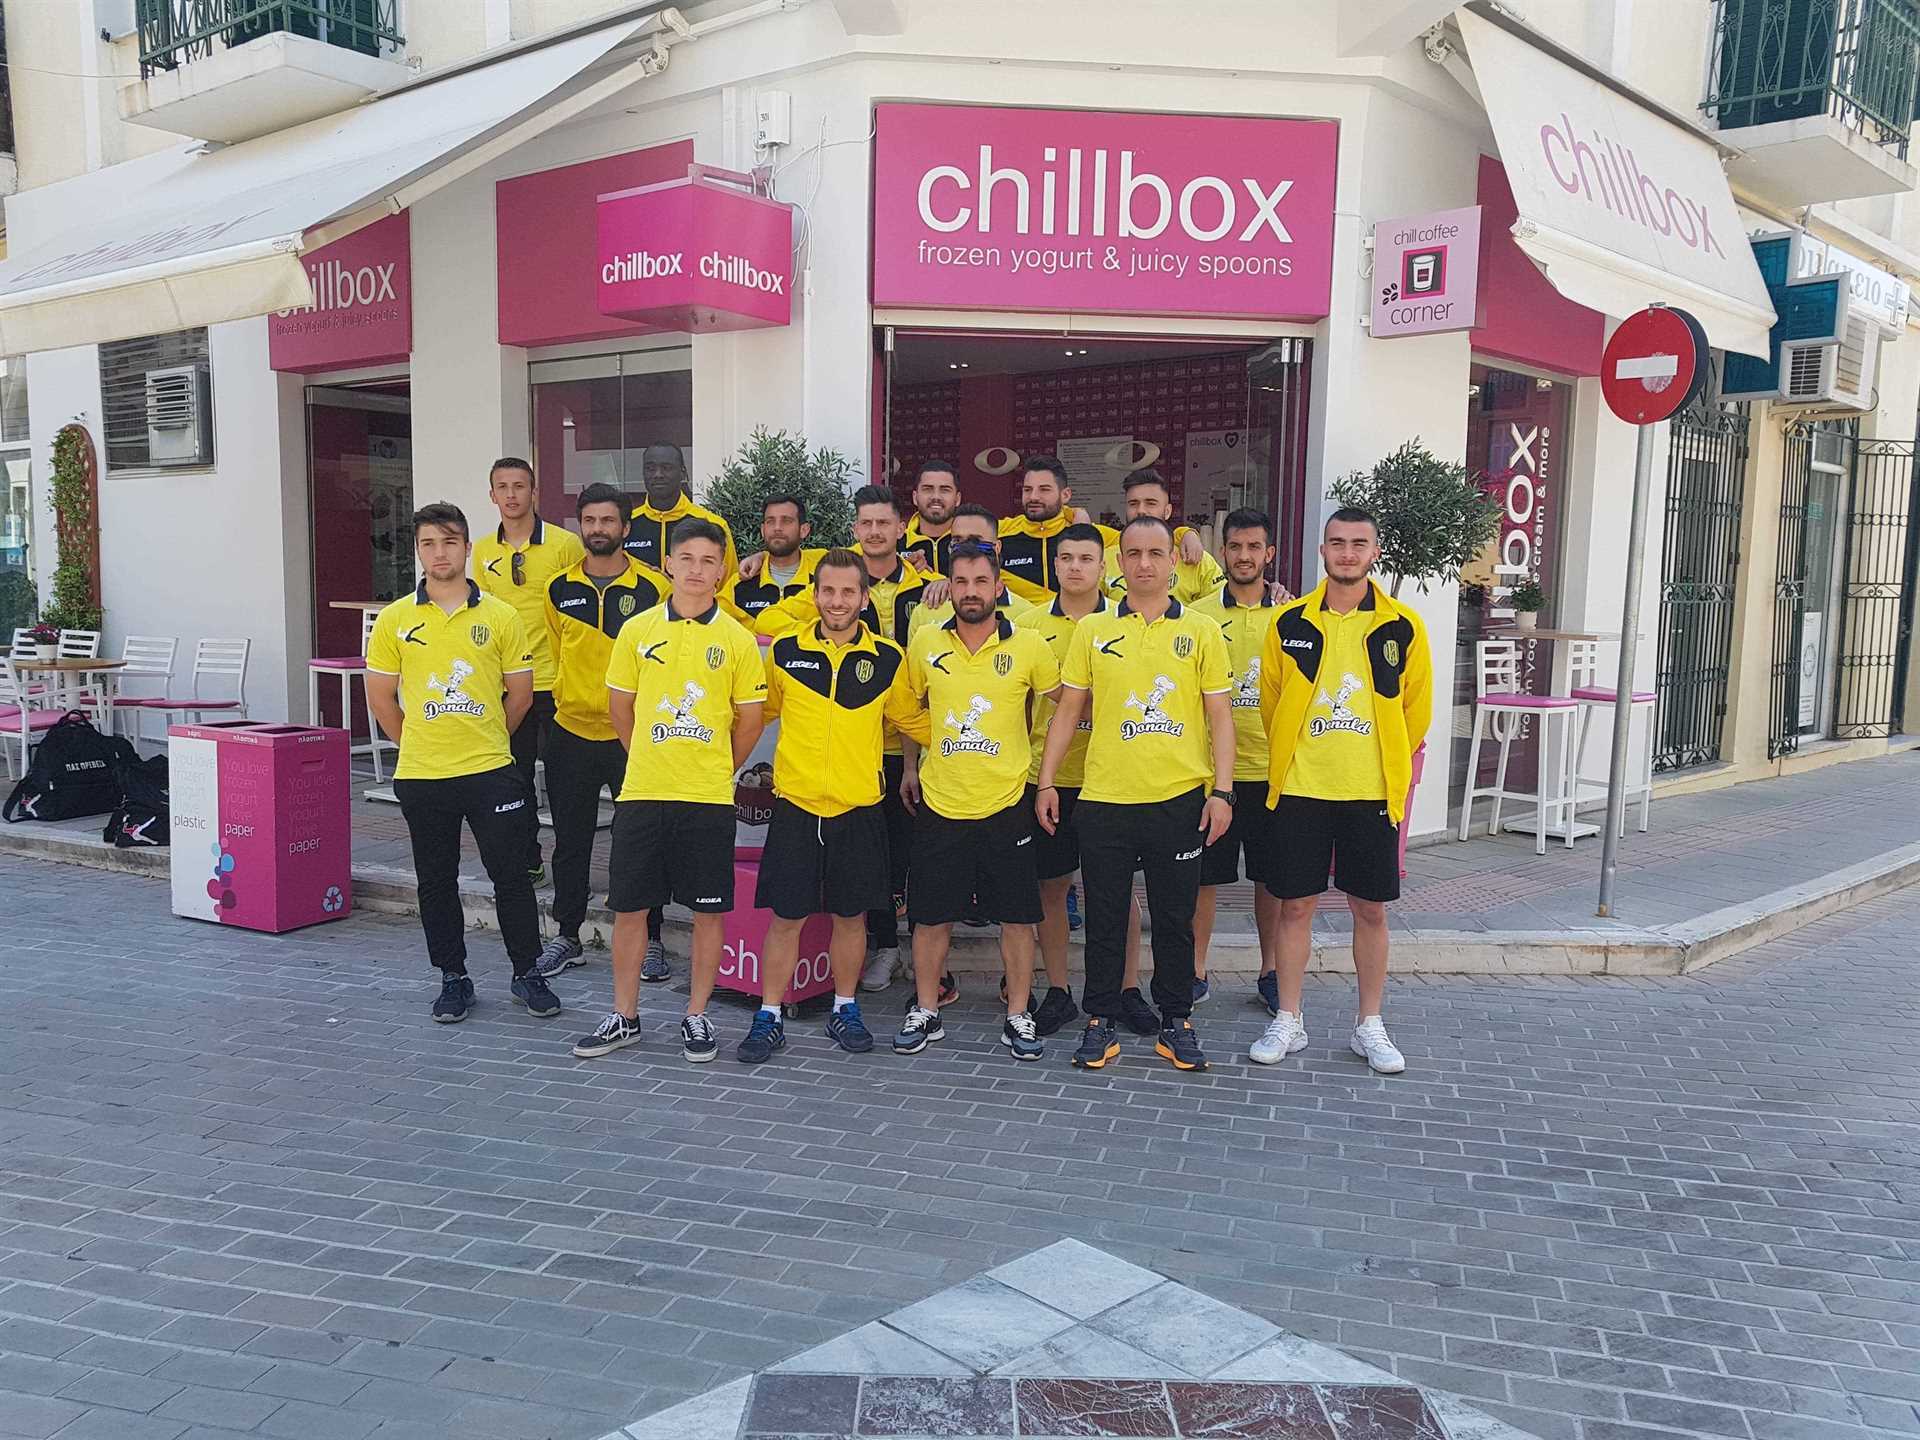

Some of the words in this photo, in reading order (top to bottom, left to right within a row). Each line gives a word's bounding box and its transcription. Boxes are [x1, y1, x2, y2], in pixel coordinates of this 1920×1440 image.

[917, 145, 1294, 244] chillbox
[1540, 112, 1727, 260] chillbox
[1393, 228, 1417, 246] chill
[1418, 223, 1459, 242] coffee
[602, 251, 683, 285] chillbox
[917, 241, 1000, 266] frozen
[1010, 247, 1094, 275] yogurt
[1102, 246, 1121, 271] &
[1128, 248, 1189, 279] juicy
[1198, 255, 1293, 279] spoons
[699, 251, 784, 295] chillbox
[276, 260, 397, 318] illbox
[1390, 302, 1455, 325] corner
[1539, 427, 1550, 478] more
[1537, 485, 1546, 498] &
[624, 540, 652, 548] LEGEA
[1533, 506, 1544, 566] cream
[1004, 557, 1033, 566] LEGEA
[560, 598, 587, 608] LEGEA
[745, 601, 770, 609] LEGEA
[785, 661, 820, 670] LEGEA
[424, 700, 485, 720] Donald
[651, 723, 714, 743] Donald
[1120, 720, 1184, 740] Donald
[941, 737, 1000, 757] Donald
[174, 815, 207, 830] plastic
[754, 806, 772, 820] bo
[225, 823, 255, 837] paper
[289, 837, 321, 856] paper
